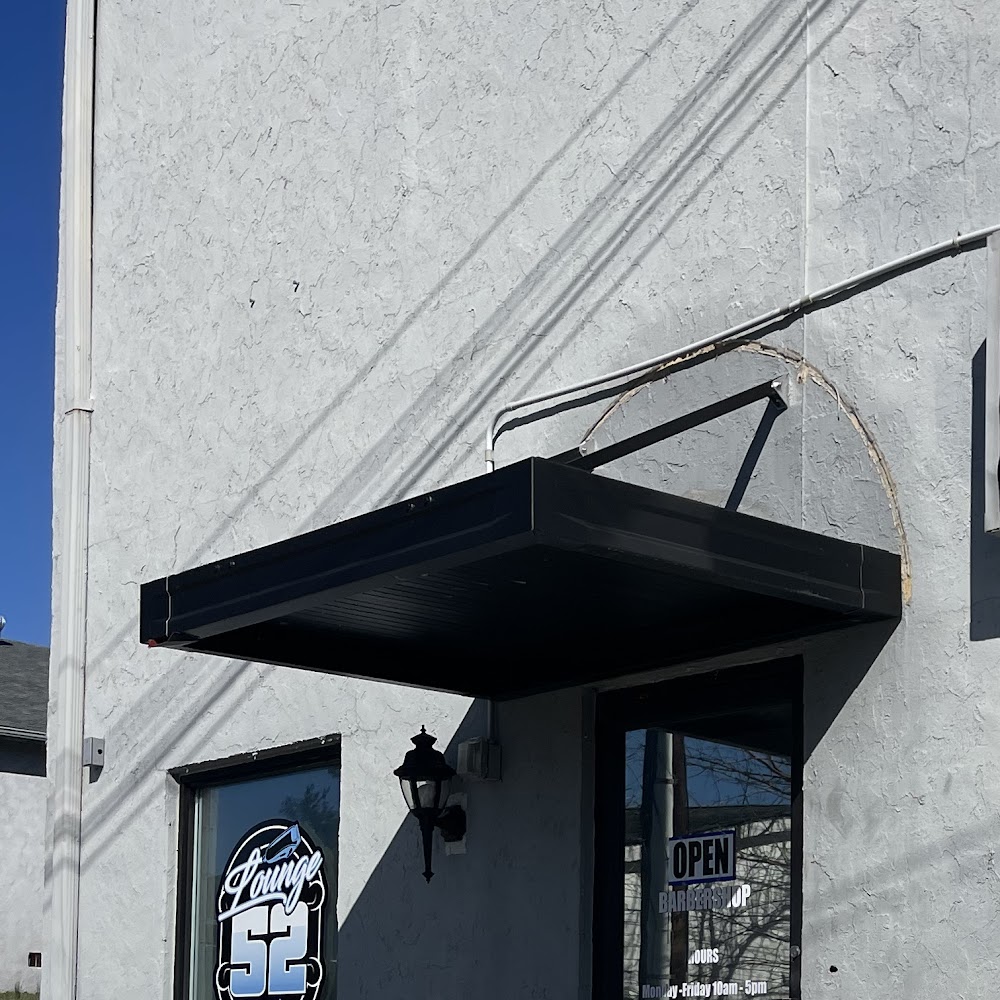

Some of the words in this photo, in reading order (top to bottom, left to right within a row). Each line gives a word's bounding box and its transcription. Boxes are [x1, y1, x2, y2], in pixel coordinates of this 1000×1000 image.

[673, 837, 729, 879] OPEN
[218, 848, 323, 922] Lounge
[658, 884, 751, 914] BARBERSHOP
[229, 900, 309, 998] 52
[642, 984, 678, 999] Monday
[712, 981, 738, 996] 10am
[744, 980, 768, 996] 5pm
